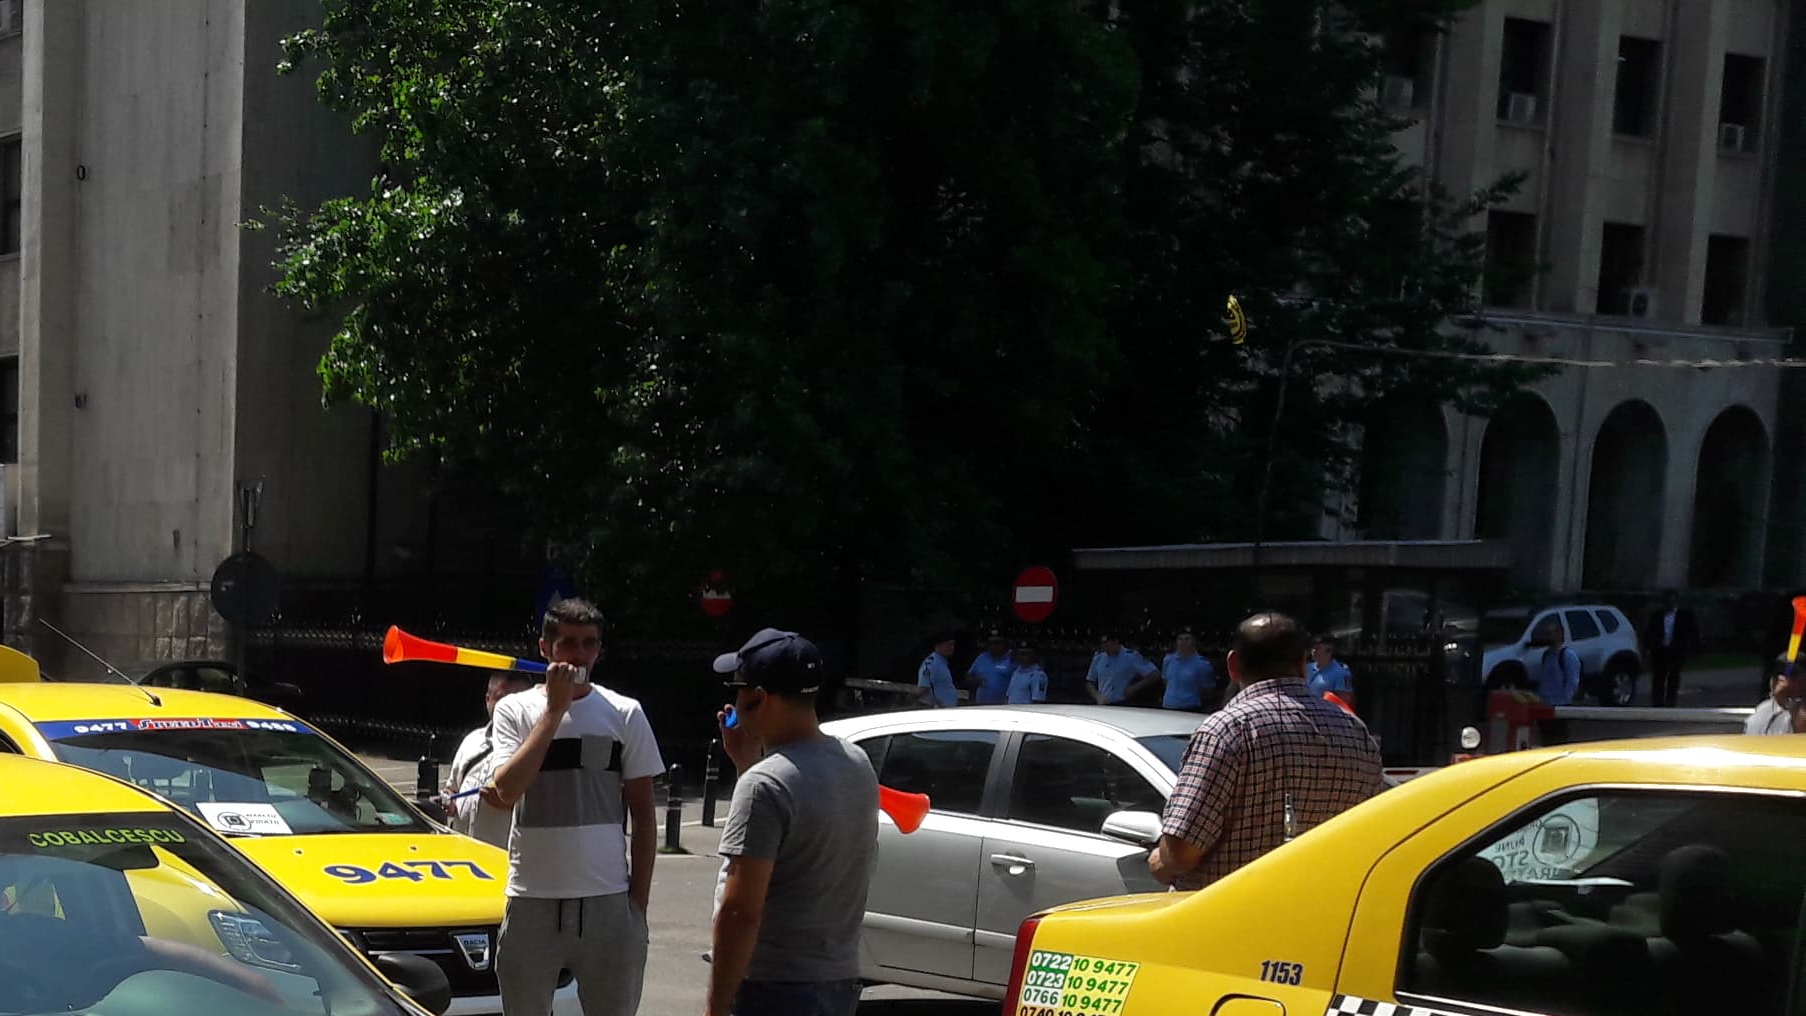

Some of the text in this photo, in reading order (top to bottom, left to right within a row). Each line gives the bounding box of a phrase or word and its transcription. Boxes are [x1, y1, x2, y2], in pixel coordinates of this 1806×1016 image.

[28, 828, 187, 848] COBALCESCU
[323, 860, 495, 885] 9477
[1031, 952, 1137, 977] 0722 10 9477
[1260, 959, 1303, 986] 1153
[1026, 970, 1129, 995] 0723 10 9477
[1023, 988, 1123, 1014] 0766 10 9477
